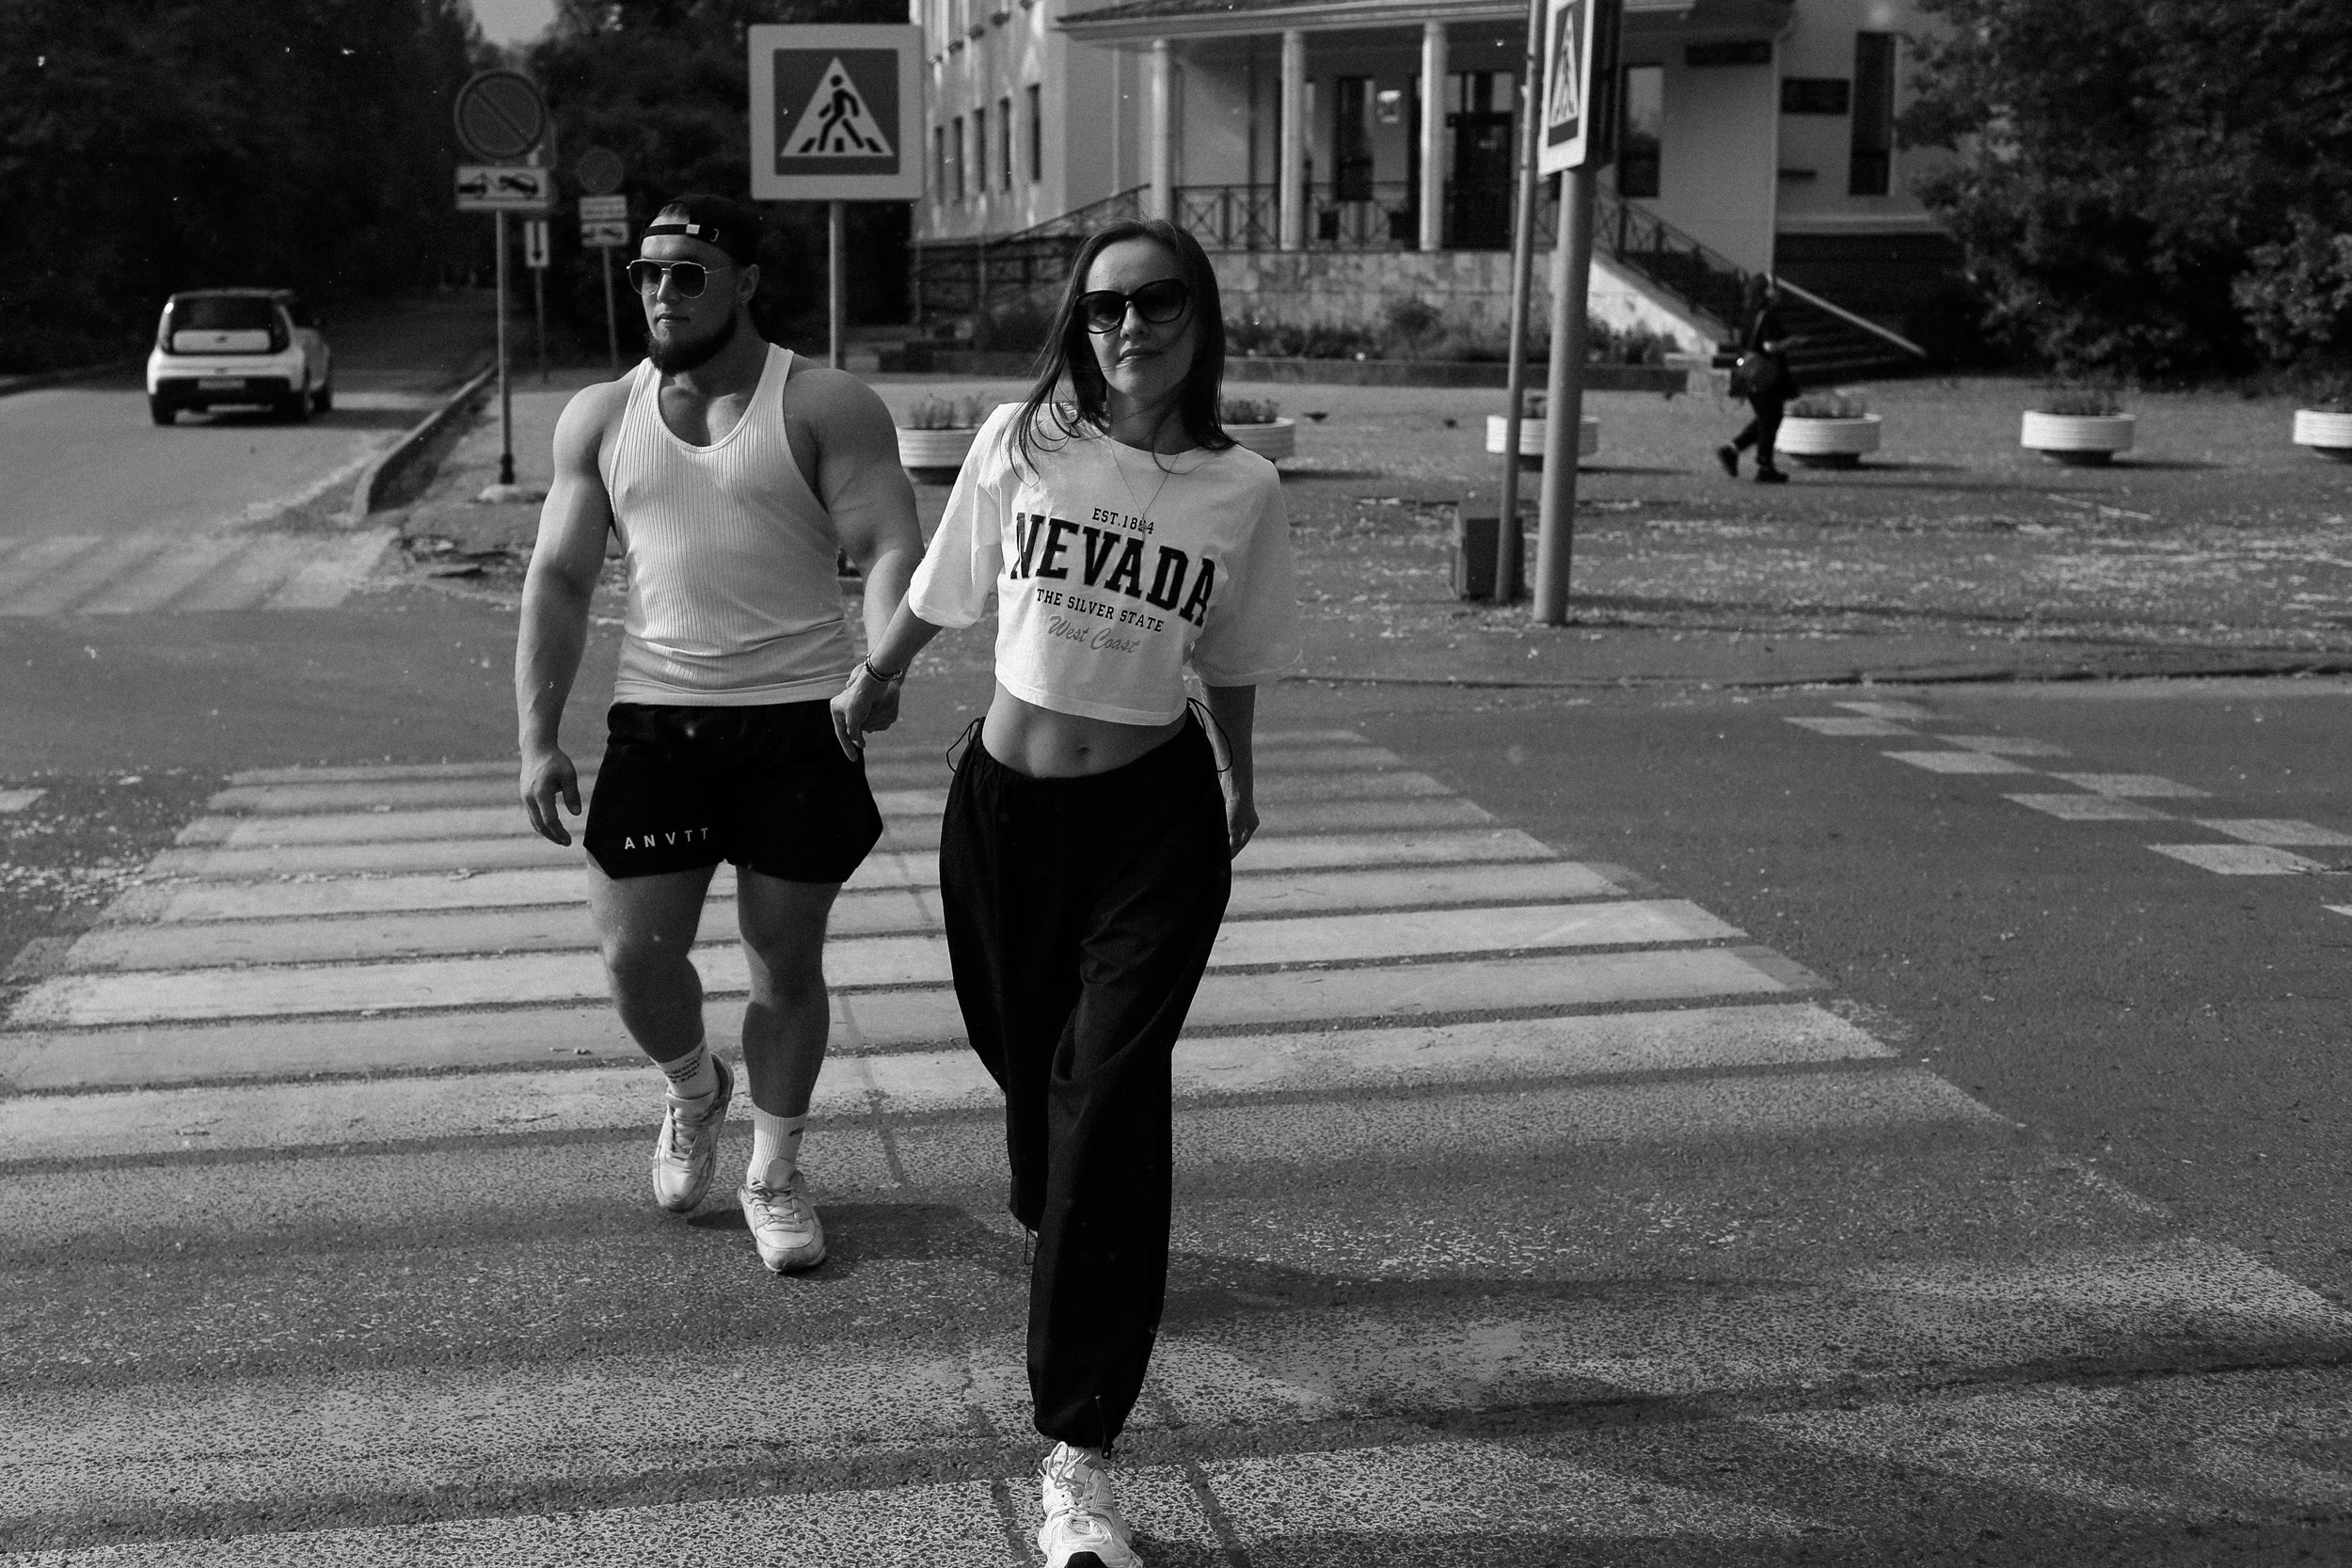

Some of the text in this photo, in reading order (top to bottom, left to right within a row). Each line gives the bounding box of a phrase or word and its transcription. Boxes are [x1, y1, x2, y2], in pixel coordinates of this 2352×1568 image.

[1010, 512, 1216, 627] NEVADA
[1037, 588, 1165, 633] THE SILVER STATE
[1048, 615, 1141, 654] West Coast
